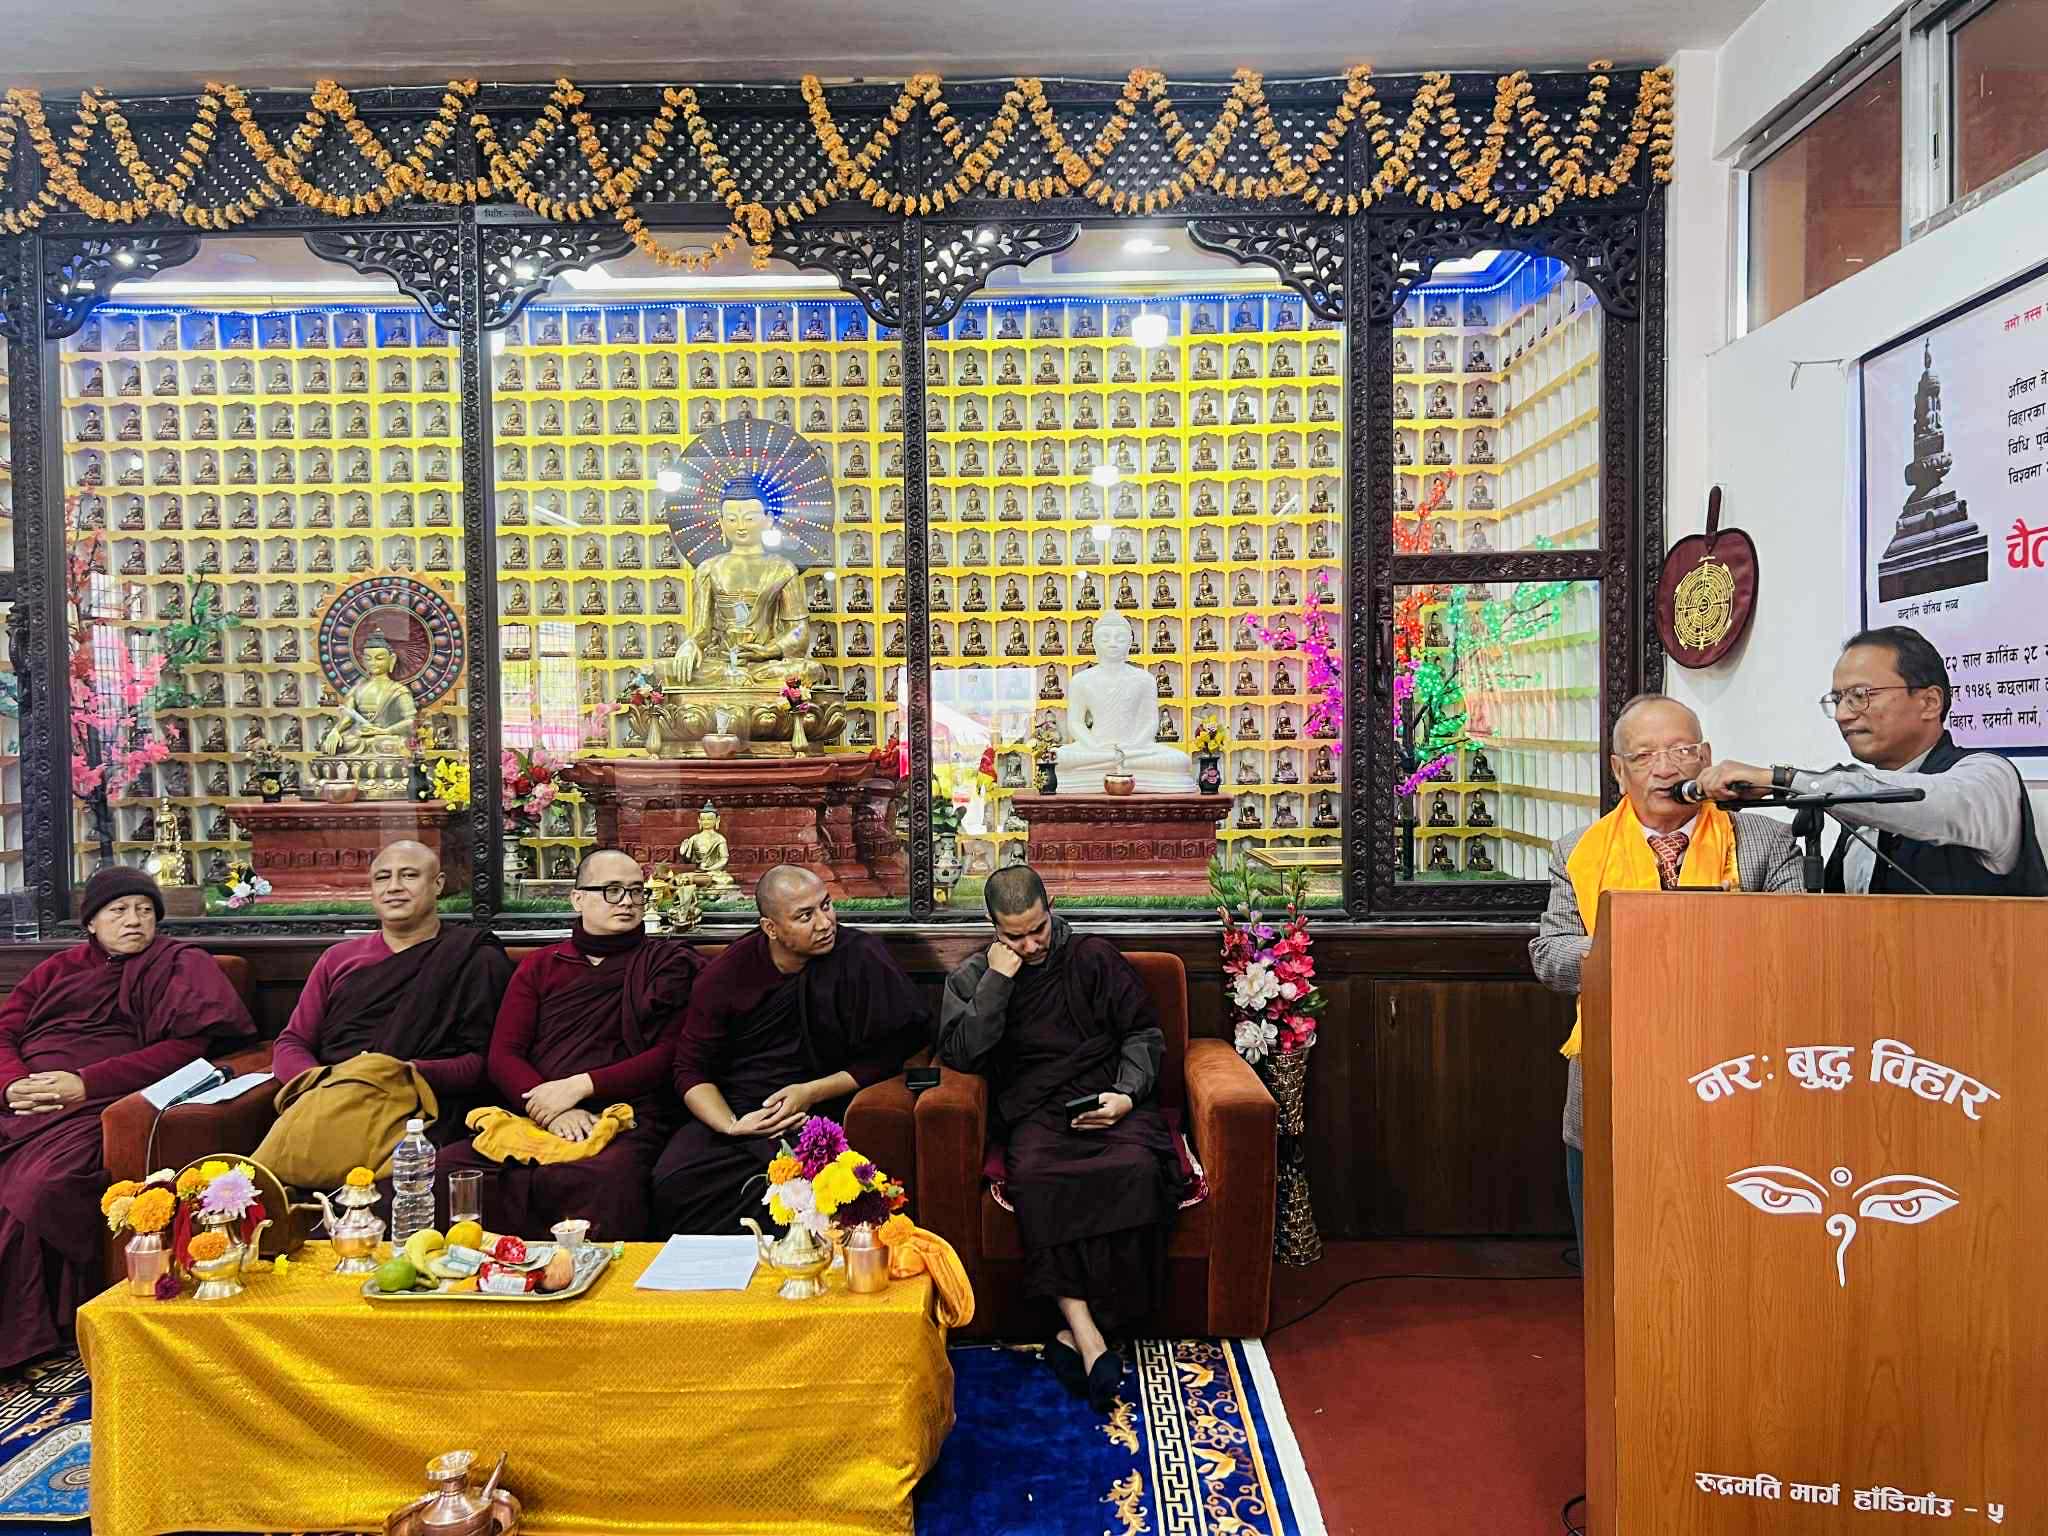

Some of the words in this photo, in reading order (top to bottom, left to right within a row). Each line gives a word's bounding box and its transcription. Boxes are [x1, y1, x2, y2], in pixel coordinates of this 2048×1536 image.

[2008, 376, 2036, 399] अखिल
[2008, 403, 2046, 427] विहारका
[2008, 435, 2030, 456] विधि
[1962, 652, 1982, 669] साल
[2024, 646, 2038, 664] २८
[1965, 682, 1991, 699] ११४६
[1786, 1046, 1854, 1091] बुद्ध
[1870, 1038, 2001, 1120] विहार
[1789, 1482, 1840, 1506] मार्ग
